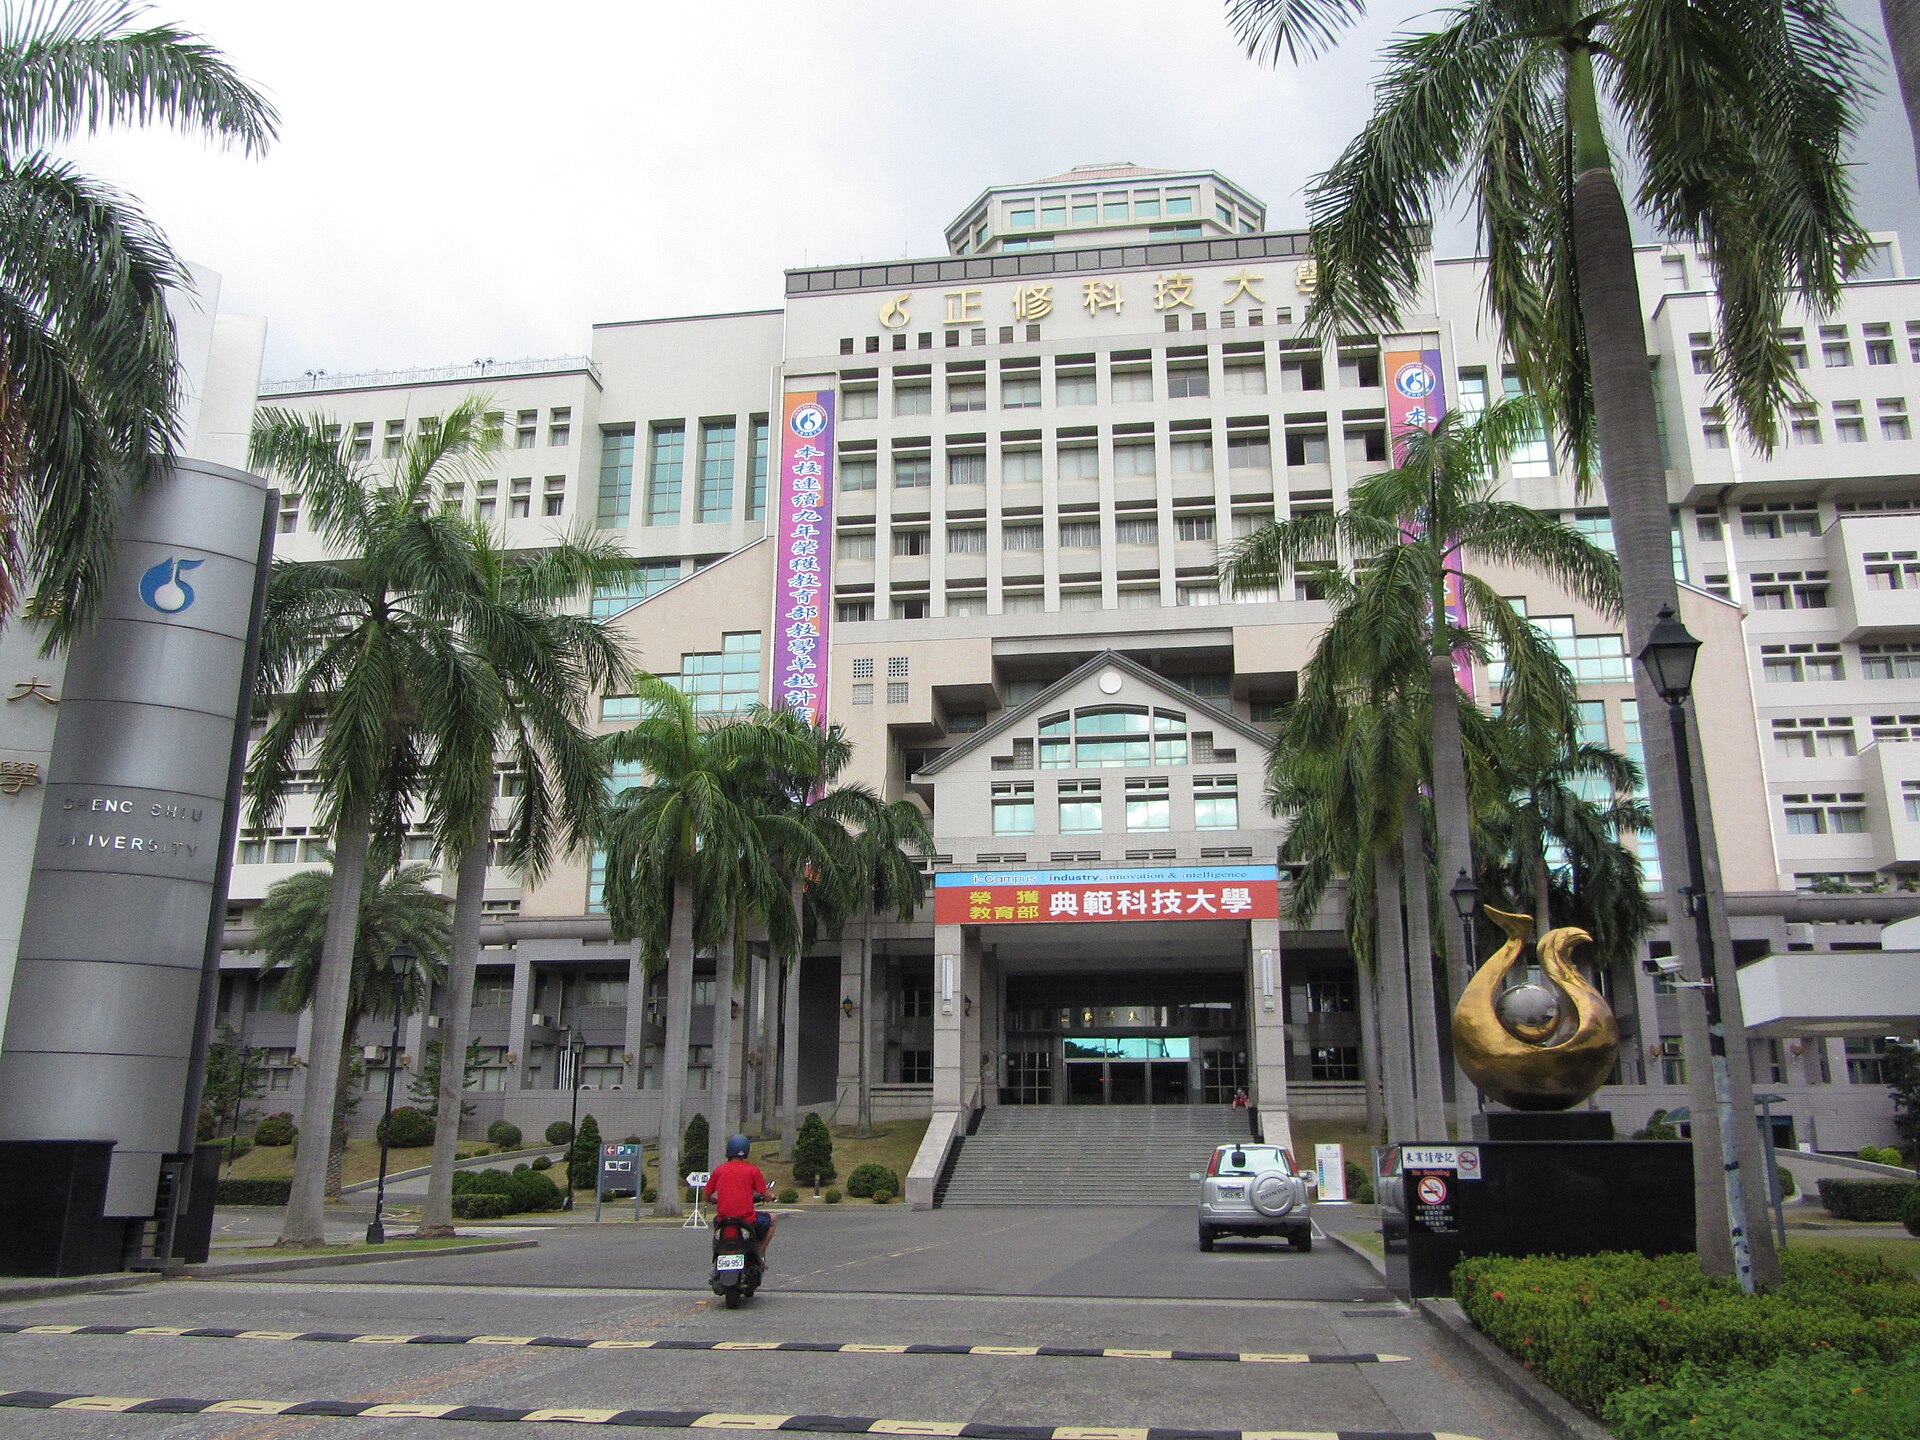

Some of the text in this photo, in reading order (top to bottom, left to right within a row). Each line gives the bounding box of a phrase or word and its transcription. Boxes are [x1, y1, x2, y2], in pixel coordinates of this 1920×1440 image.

[150, 800, 204, 823] SHIU
[973, 873, 1037, 884] i-Campus
[1049, 888, 1252, 917] 典範科技大學
[969, 905, 1040, 920] 教育部
[617, 1146, 624, 1154] P
[1260, 1187, 1288, 1200] HONDA
